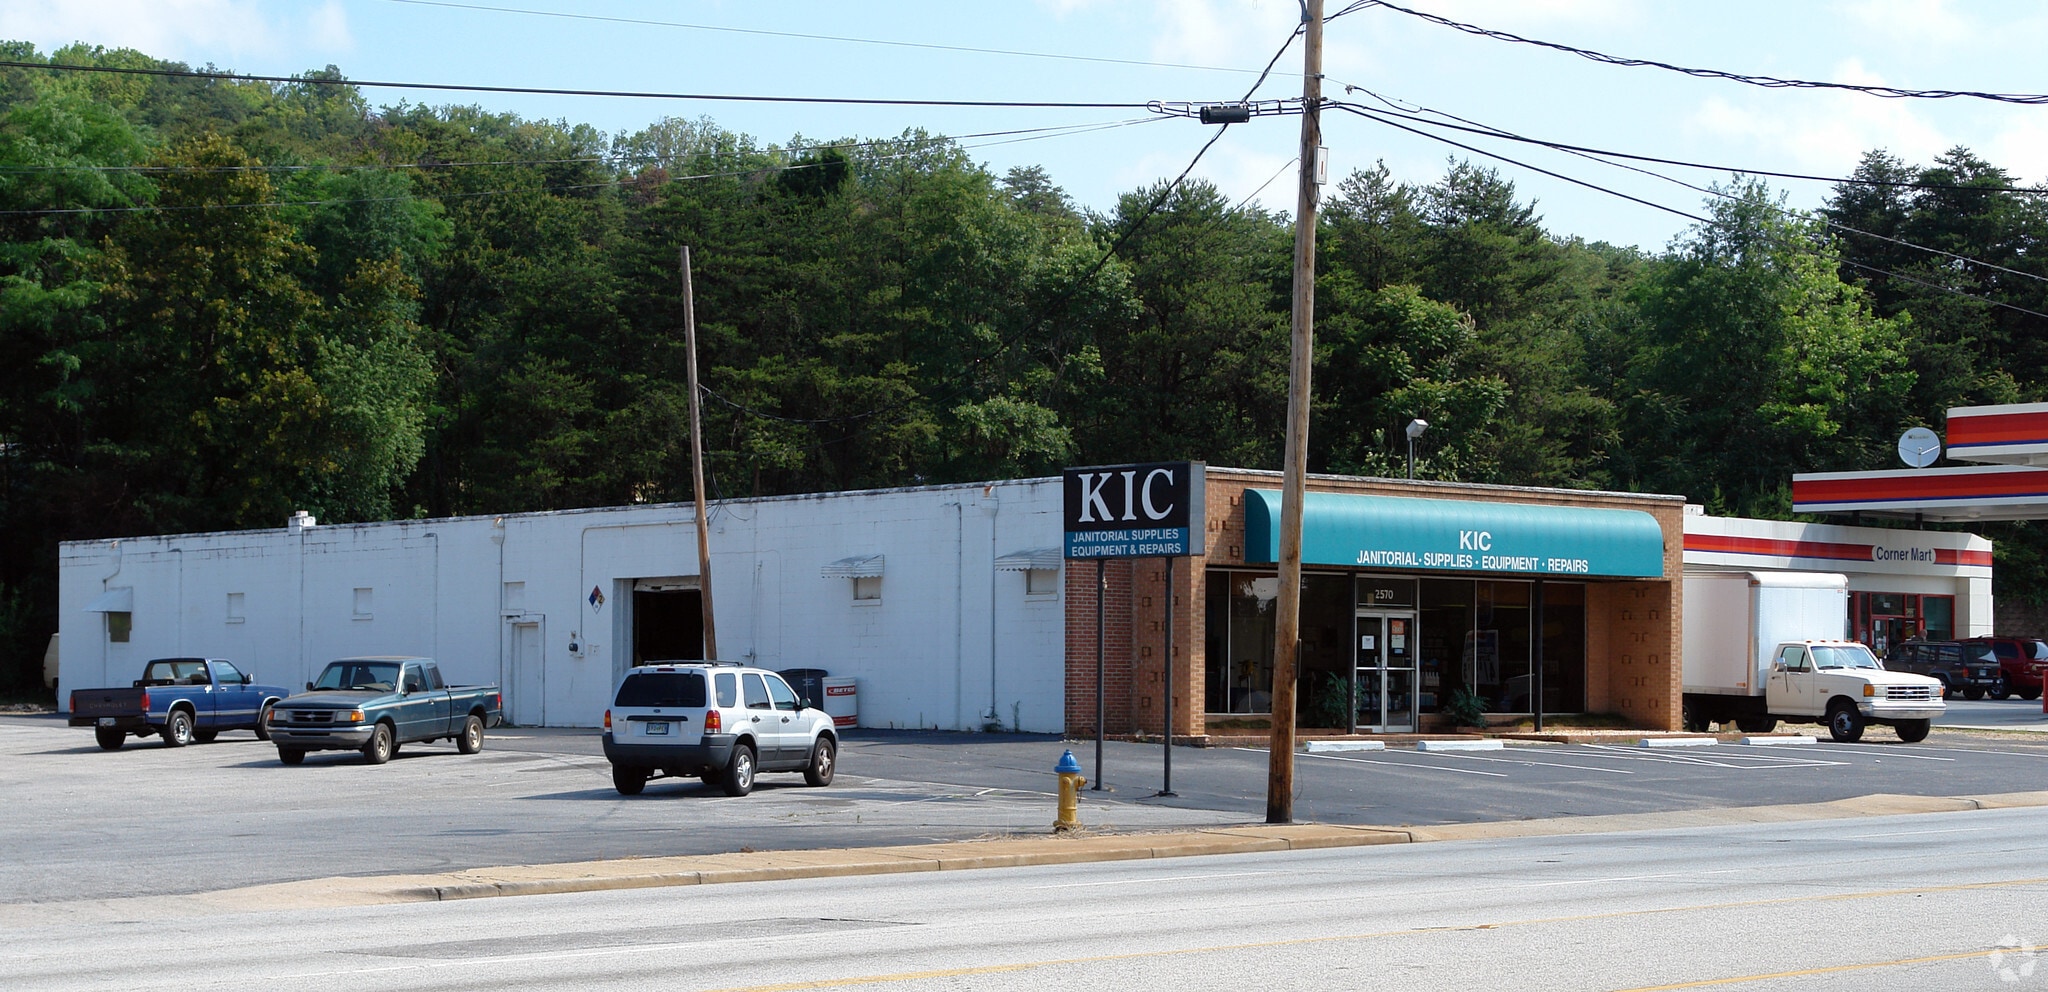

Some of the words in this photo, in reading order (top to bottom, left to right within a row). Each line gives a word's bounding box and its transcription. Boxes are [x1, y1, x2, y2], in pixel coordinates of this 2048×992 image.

[1078, 468, 1174, 523] KIC
[1072, 531, 1129, 543] JANITORIAL
[1131, 528, 1179, 541] SUPPLIES
[1459, 530, 1492, 551] KIC
[1071, 544, 1128, 557] EQUIPMENT
[1129, 544, 1137, 555] &
[1139, 542, 1182, 555] REPAIRS
[1876, 546, 1909, 561] Corner
[1911, 547, 1932, 561] Mart
[1423, 552, 1473, 568] SUPPLIES
[1481, 555, 1539, 571] EQUIPMENT
[1547, 558, 1589, 573] REPAIRS
[1375, 589, 1394, 600] 2570
